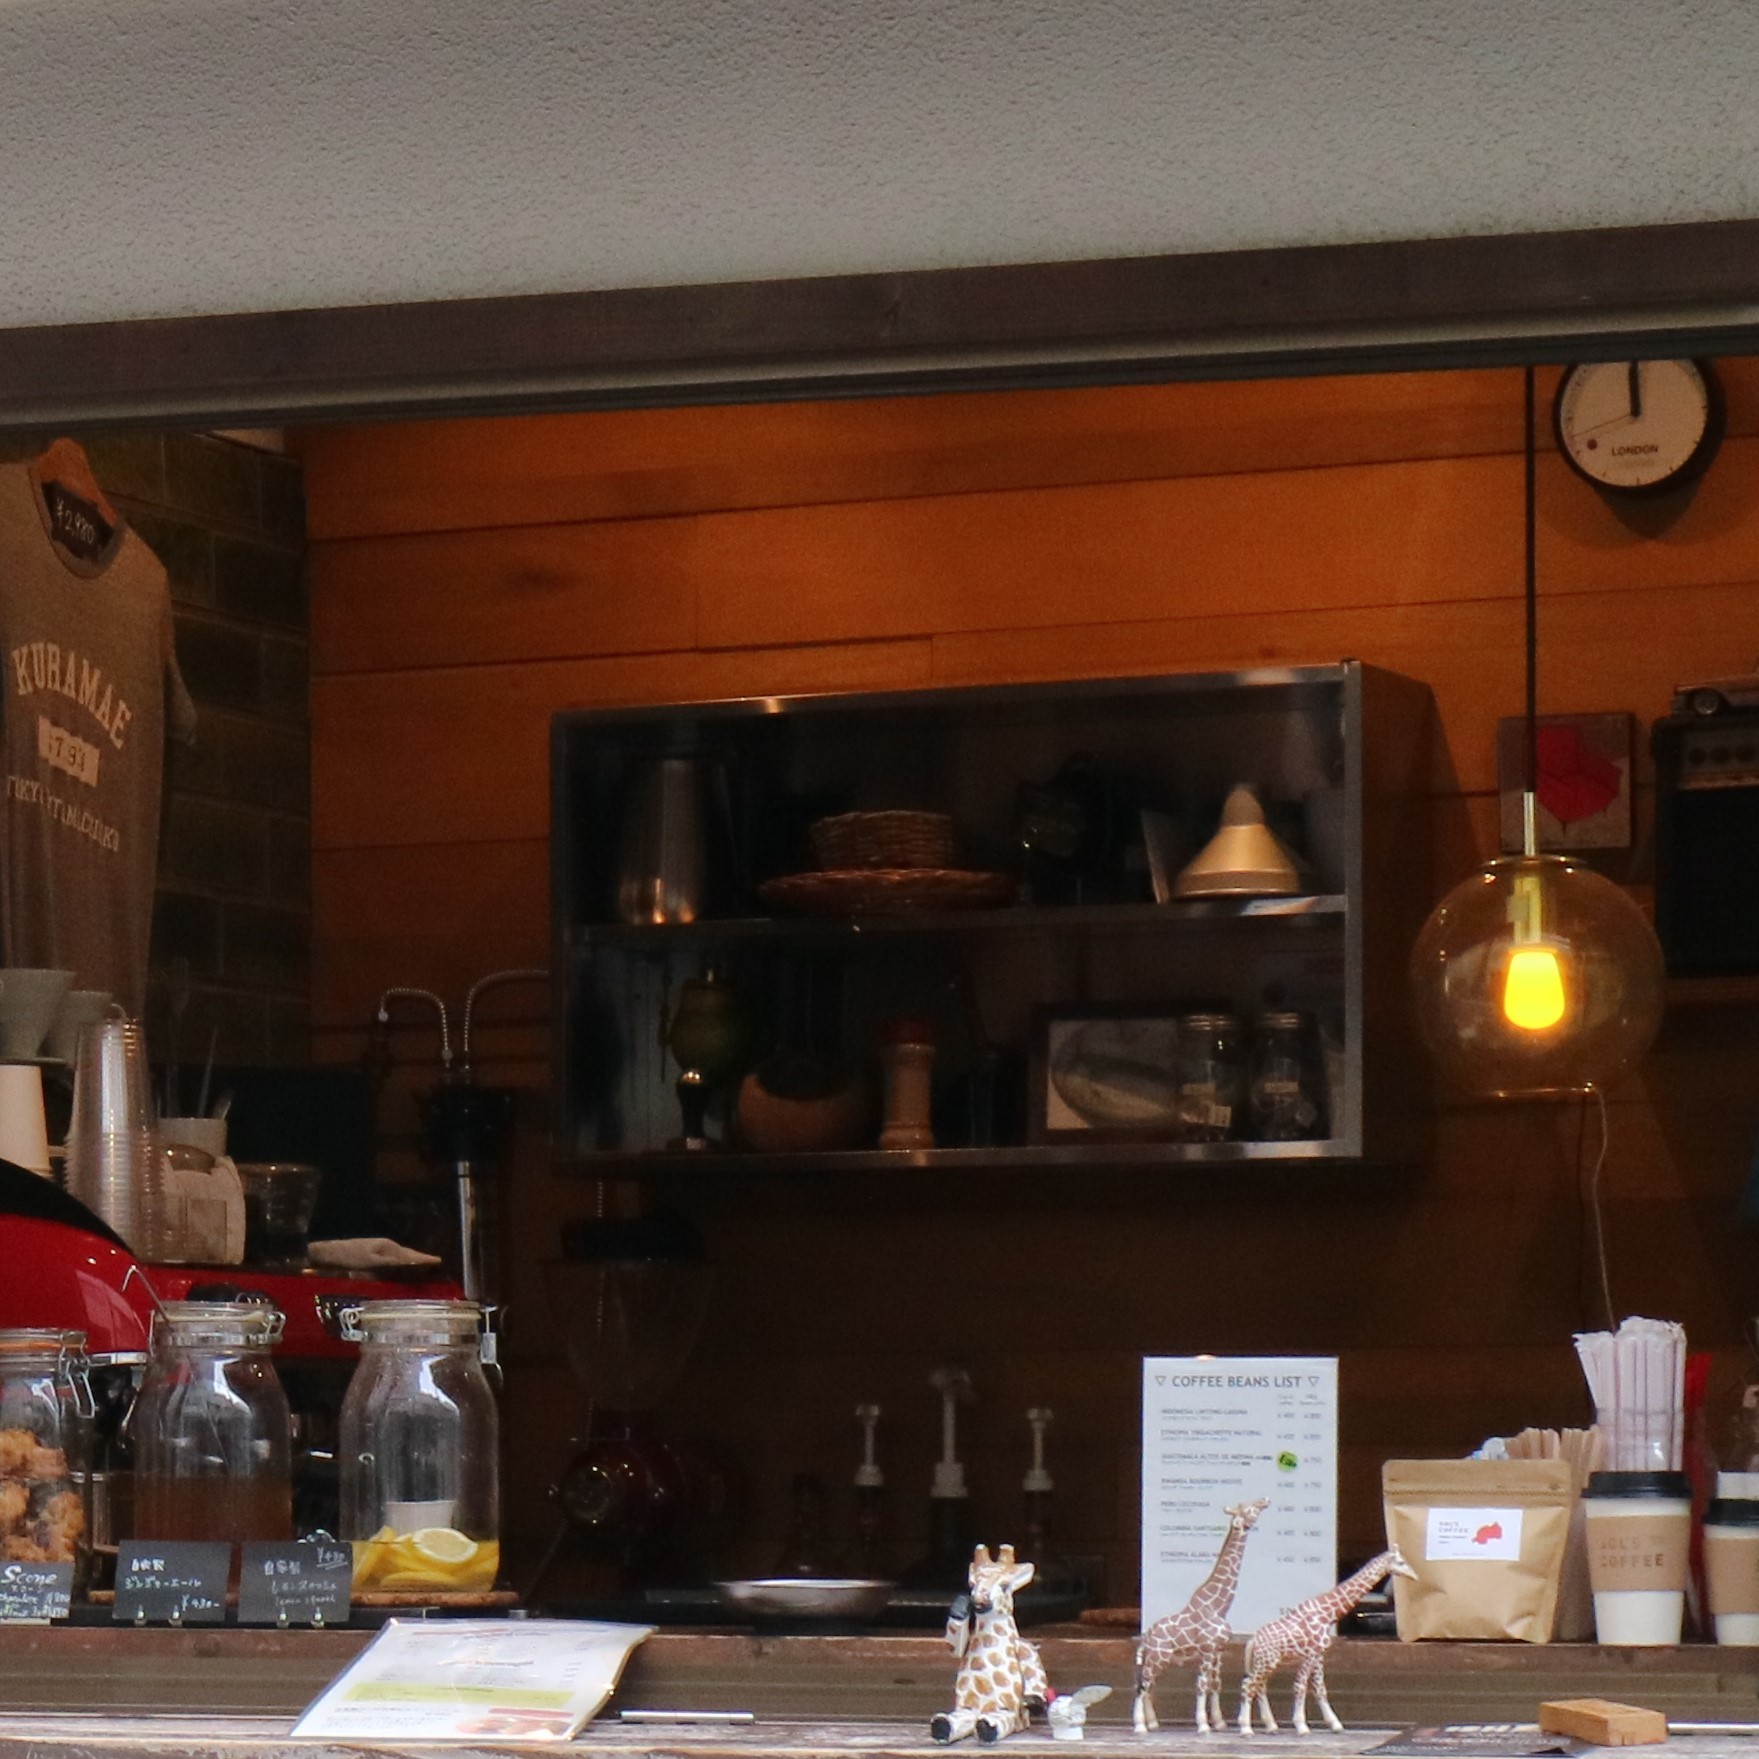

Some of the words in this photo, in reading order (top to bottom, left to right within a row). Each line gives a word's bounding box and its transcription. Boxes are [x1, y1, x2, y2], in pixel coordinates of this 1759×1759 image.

[1611, 443, 1659, 456] LONDON
[12, 642, 132, 750] KURAMAE
[1172, 1375, 1223, 1388] COFFEE
[1227, 1375, 1270, 1388] BEANS
[1274, 1375, 1302, 1388] LIST
[0, 1565, 58, 1586] Scone
